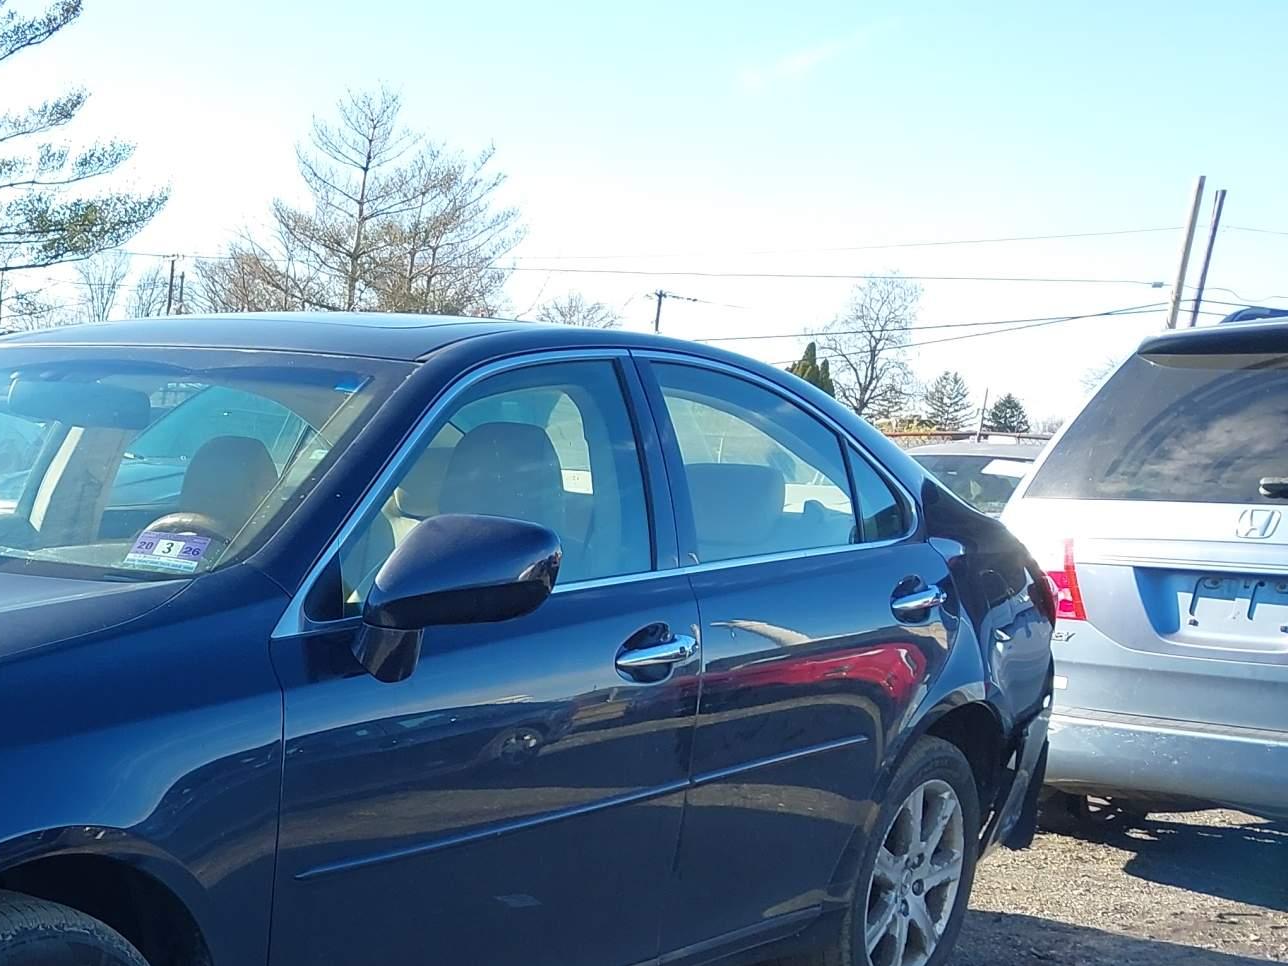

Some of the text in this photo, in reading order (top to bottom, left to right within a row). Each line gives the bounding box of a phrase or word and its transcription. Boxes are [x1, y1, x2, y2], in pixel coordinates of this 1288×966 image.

[136, 541, 201, 556] 20 3 26
